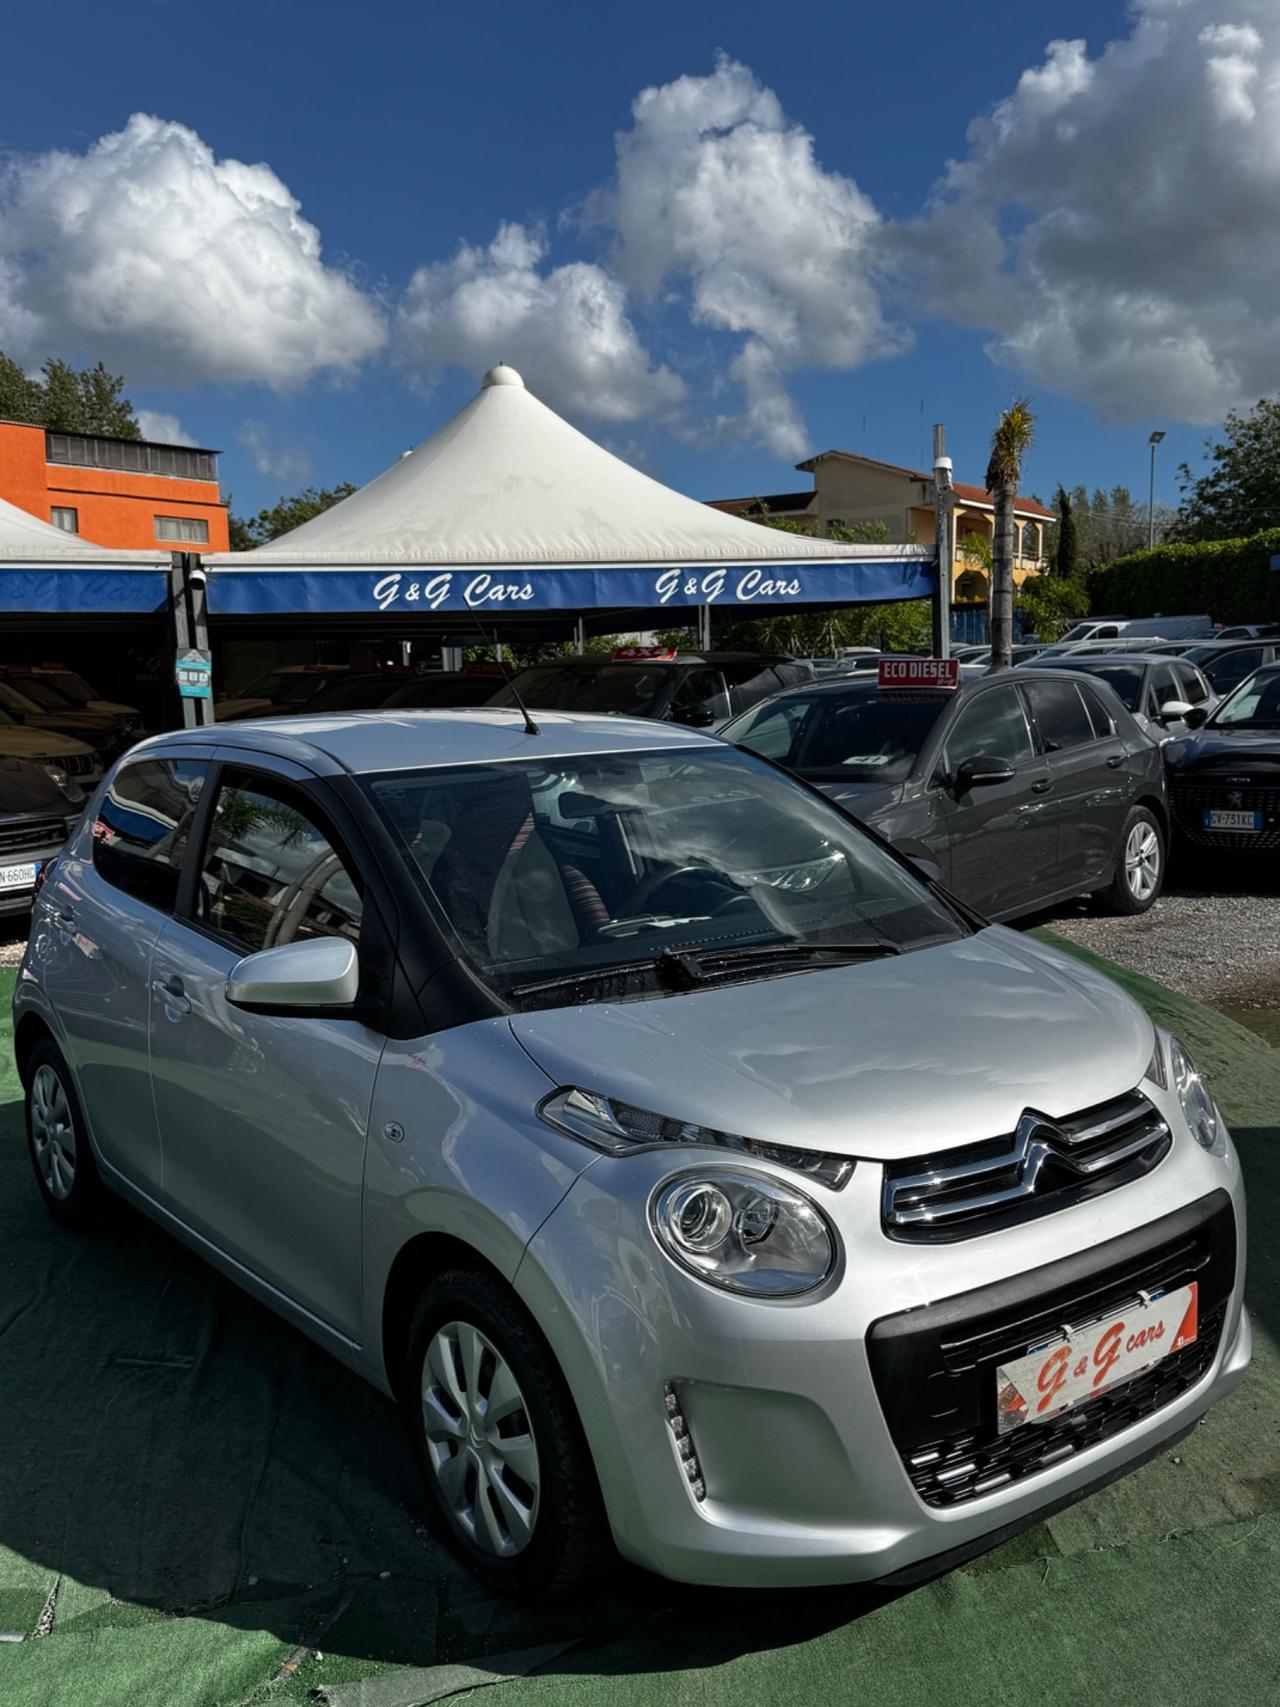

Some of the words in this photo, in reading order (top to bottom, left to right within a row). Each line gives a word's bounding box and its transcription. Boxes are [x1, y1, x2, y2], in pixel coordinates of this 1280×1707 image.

[464, 573, 535, 607] Cars
[735, 569, 802, 602] Cars
[884, 661, 907, 679] ECO
[909, 661, 953, 679] DIESEL
[1126, 1320, 1166, 1353] cars
